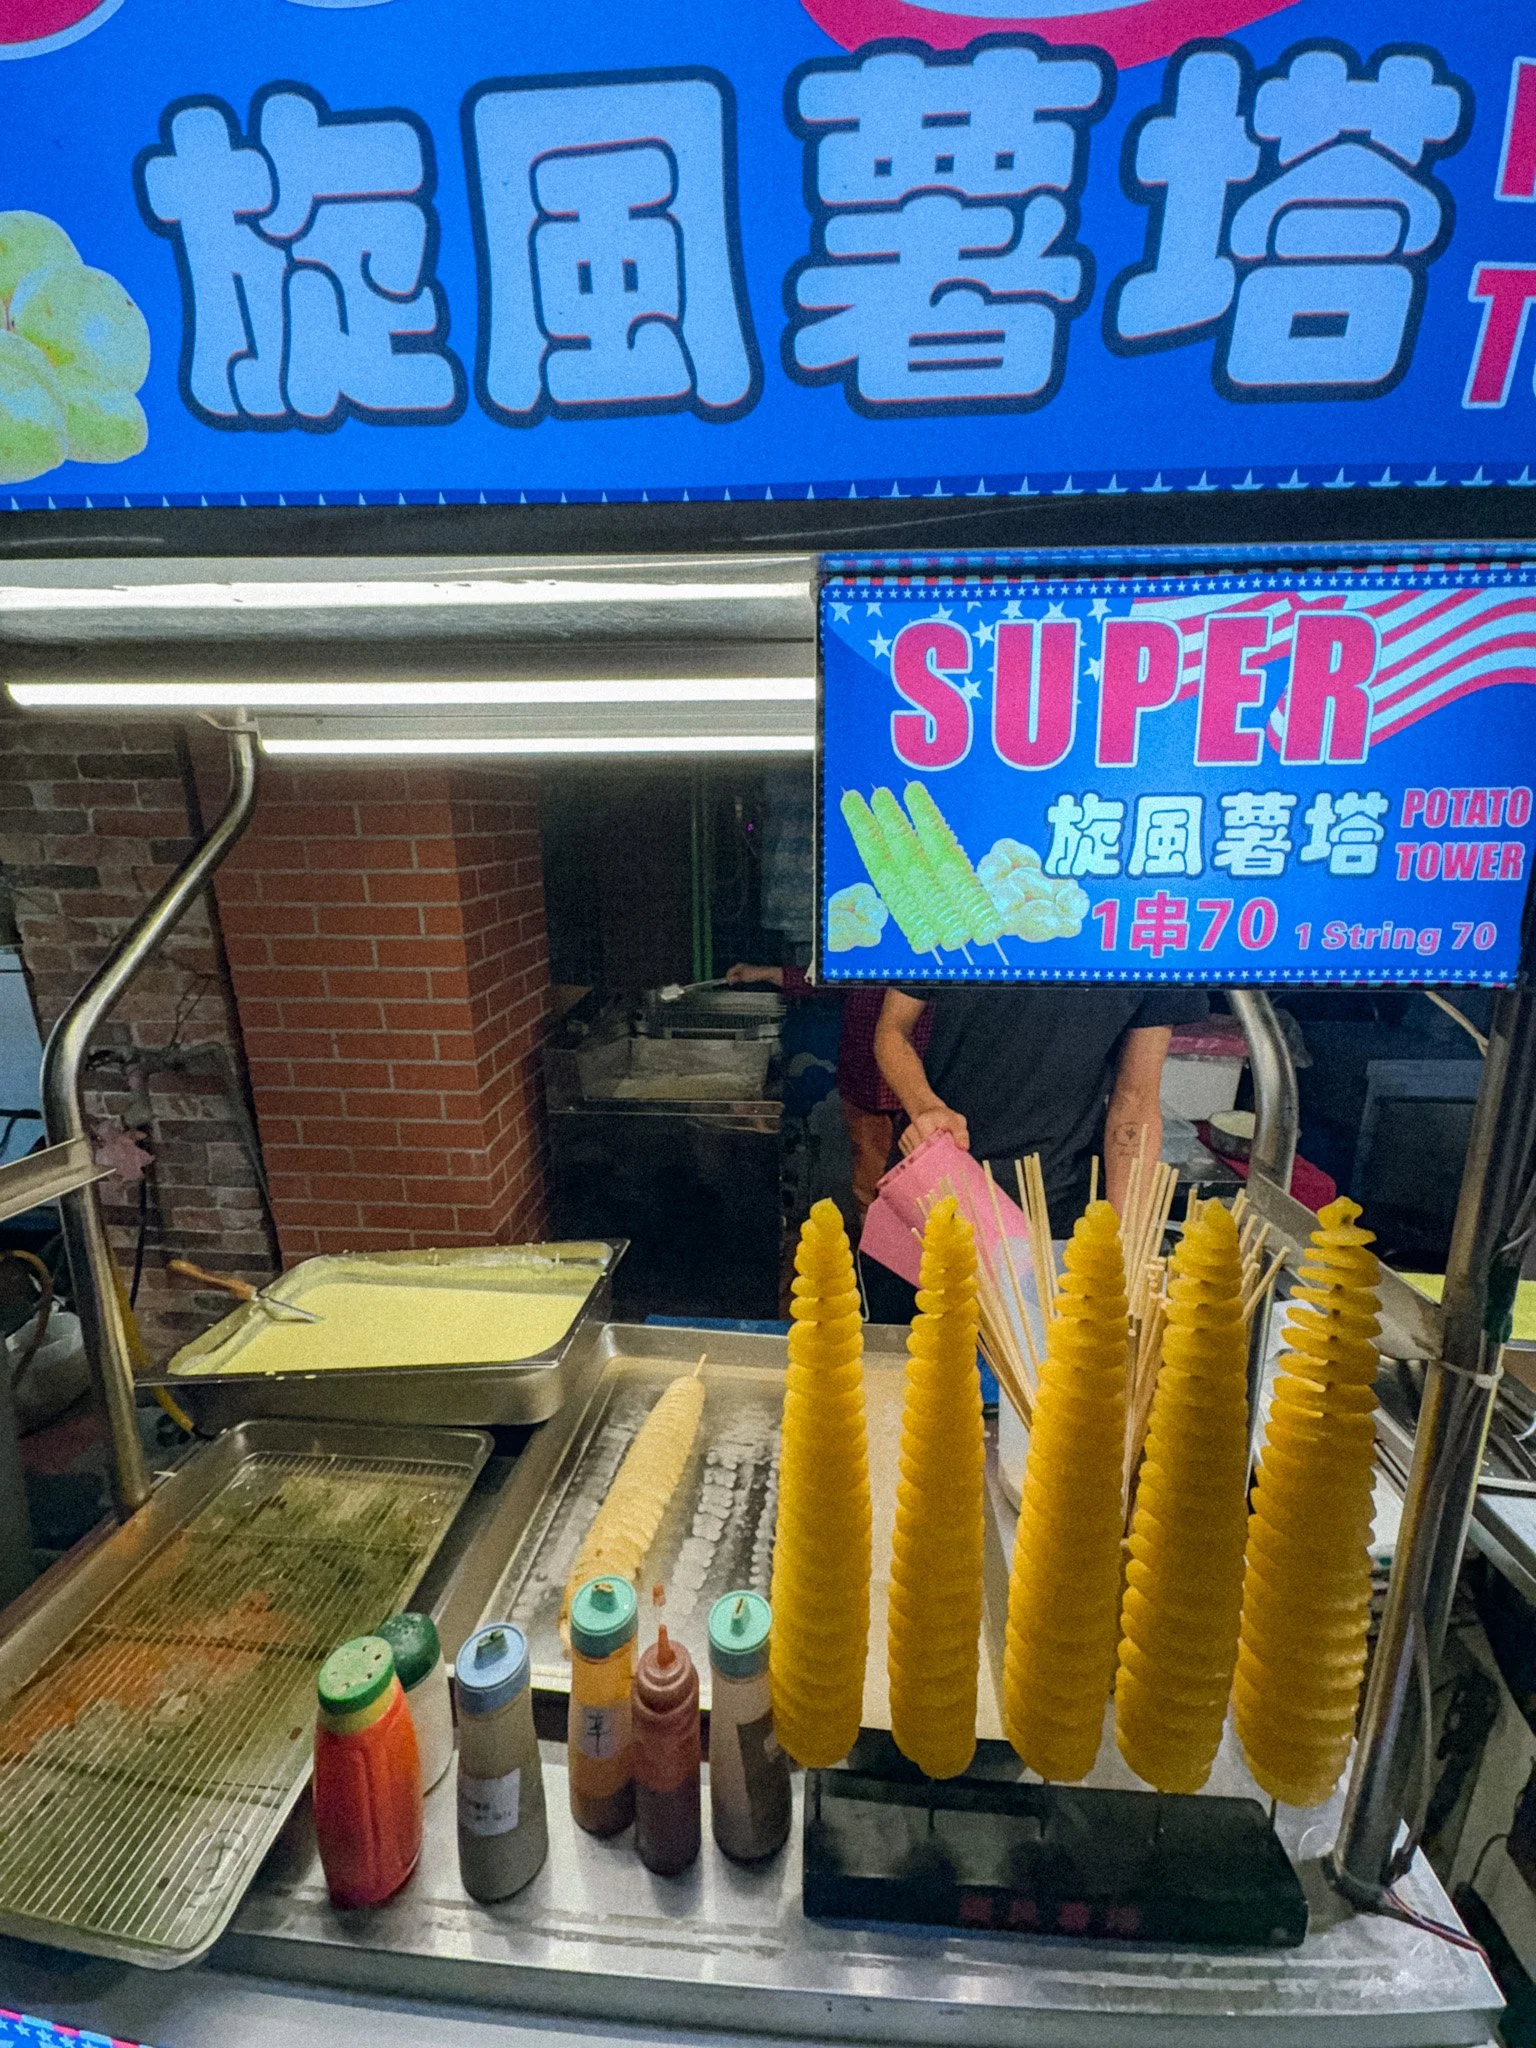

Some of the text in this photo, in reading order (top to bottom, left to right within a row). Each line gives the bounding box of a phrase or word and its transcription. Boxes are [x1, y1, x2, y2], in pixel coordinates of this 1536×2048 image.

[135, 36, 1472, 430] 旋風薯塔
[891, 612, 1381, 770] SUPER
[1042, 789, 1390, 879] 旋風薯塔
[1401, 786, 1533, 828] POTATO
[1397, 841, 1526, 882] TOWER
[1295, 920, 1497, 956] 1 String 70
